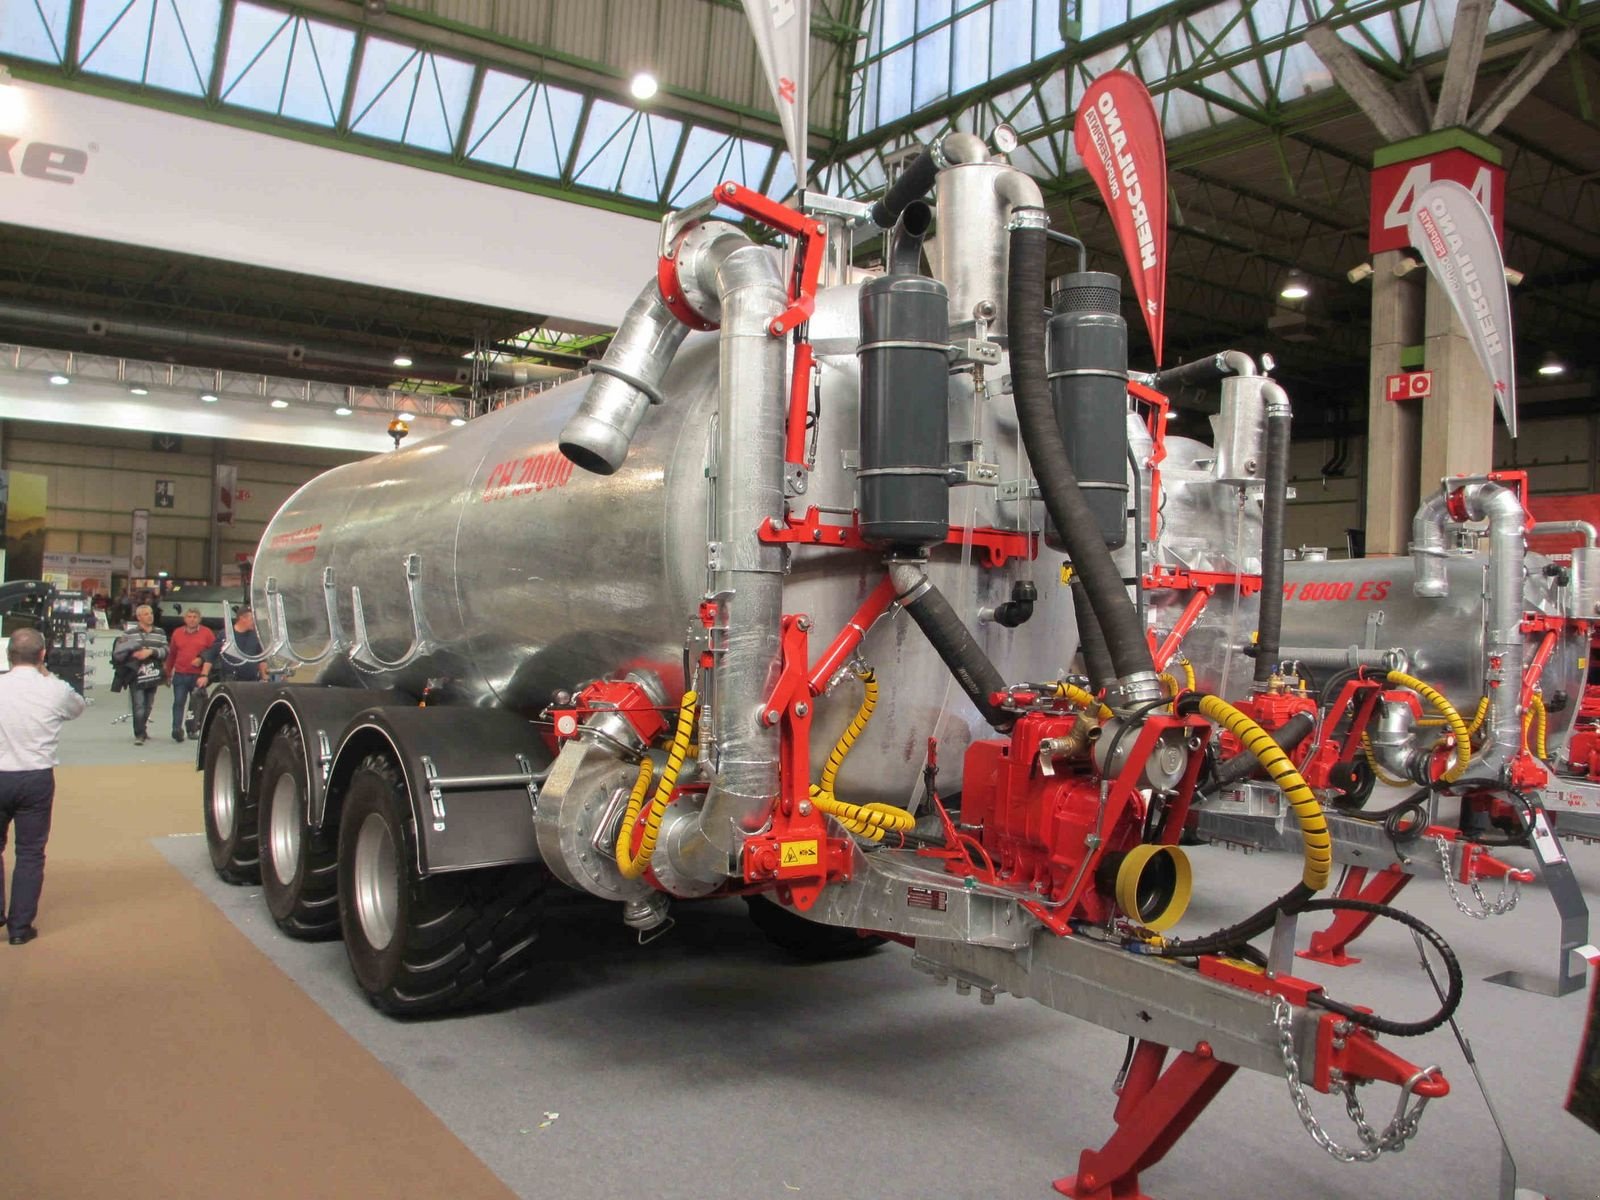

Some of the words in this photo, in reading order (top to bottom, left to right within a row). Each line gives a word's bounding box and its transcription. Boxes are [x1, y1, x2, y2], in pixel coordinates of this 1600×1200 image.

[1383, 162, 1432, 230] 4
[1299, 581, 1355, 602] 8000
[1356, 581, 1393, 602] ES
